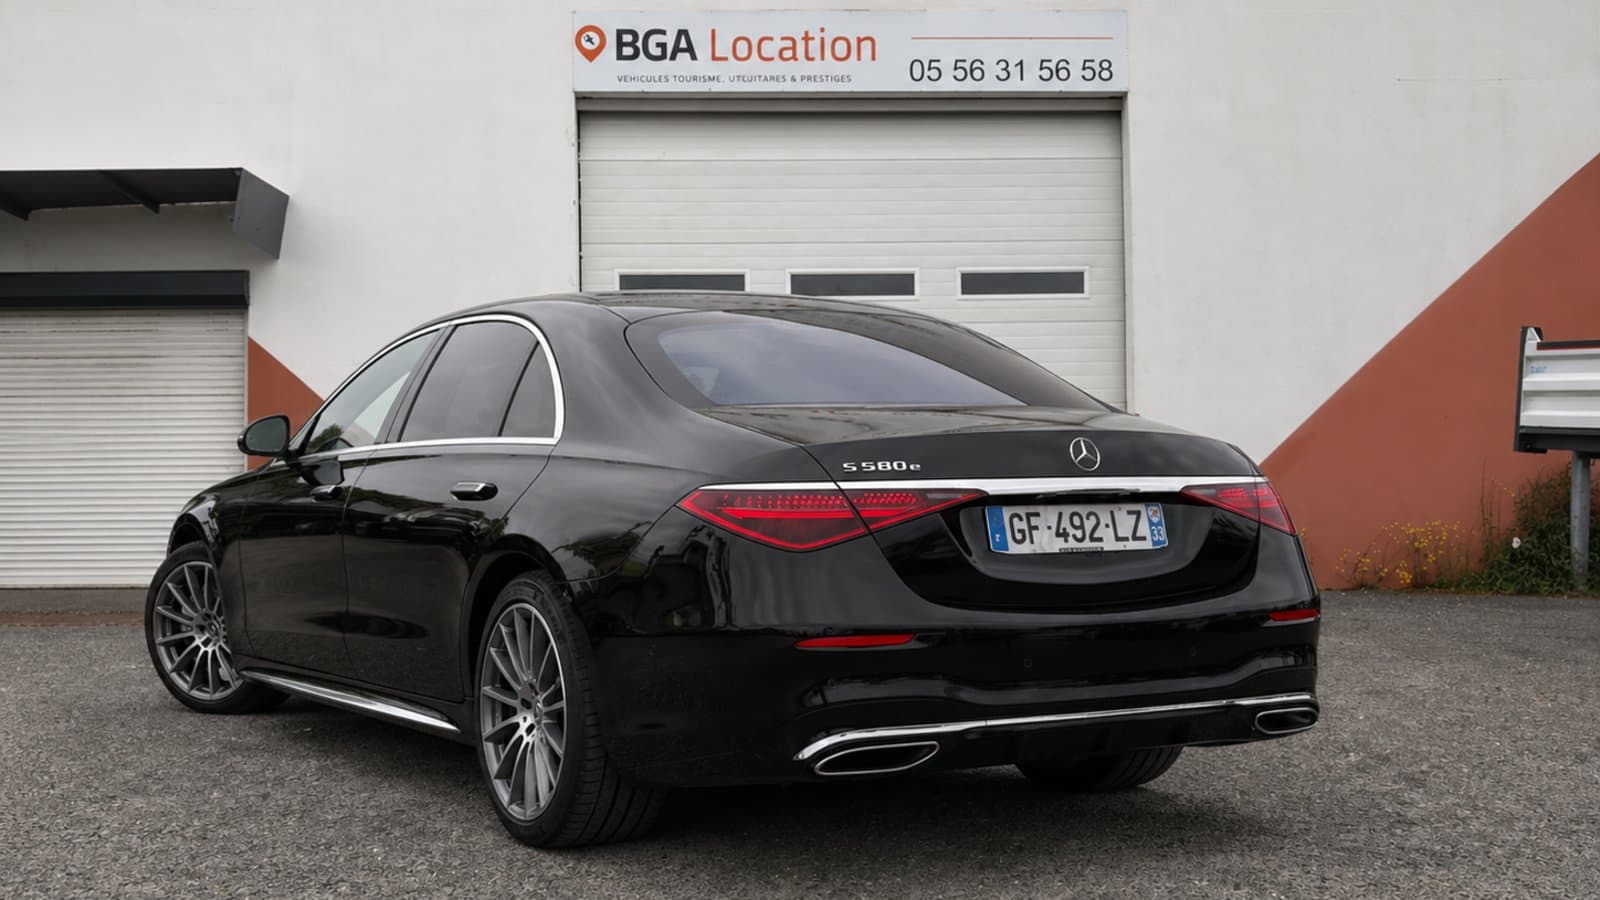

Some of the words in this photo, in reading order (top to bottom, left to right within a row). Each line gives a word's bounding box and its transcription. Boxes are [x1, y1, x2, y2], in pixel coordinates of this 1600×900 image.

[615, 28, 698, 62] BGA
[710, 27, 877, 62] Location
[909, 58, 942, 82] 05
[952, 58, 985, 82] 56
[995, 58, 1024, 82] 31
[1038, 58, 1071, 82] 56
[1081, 58, 1113, 82] 58
[800, 74, 853, 83] PRESTIGES
[842, 462, 857, 472] S
[1151, 526, 1165, 541] 33
